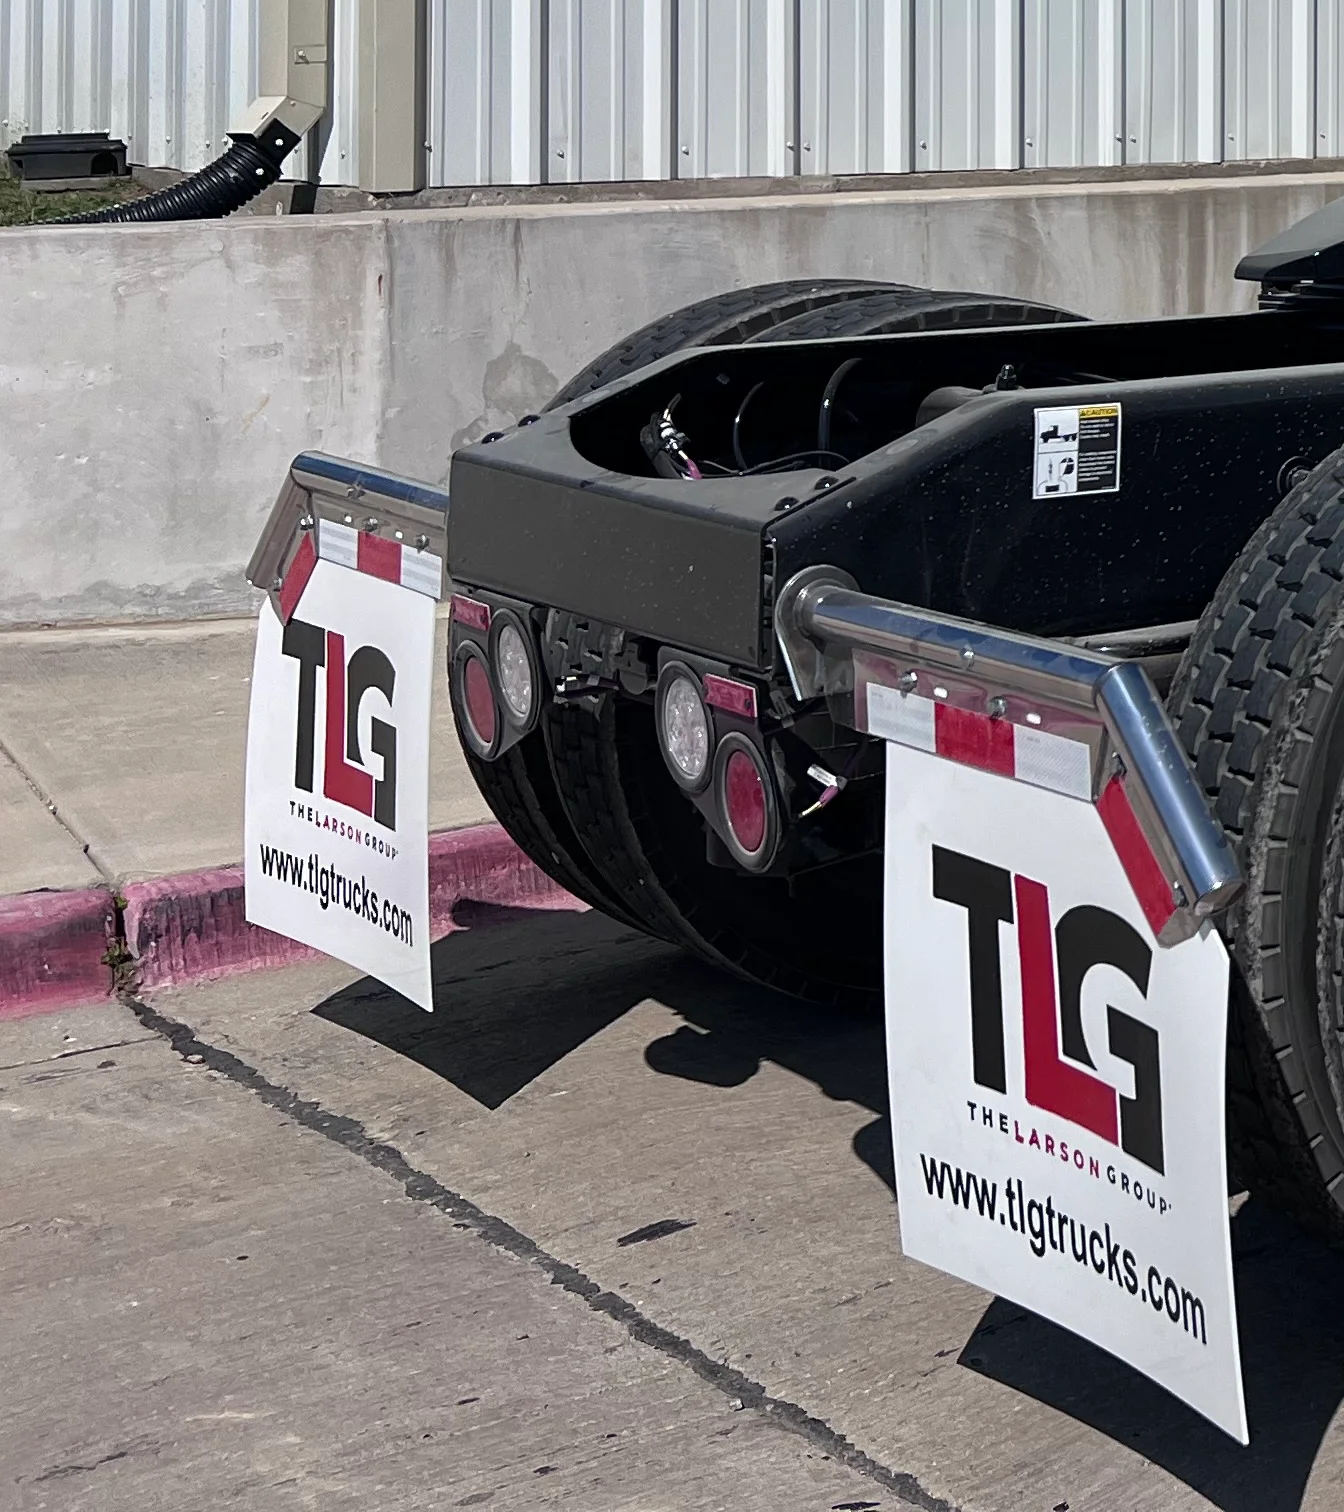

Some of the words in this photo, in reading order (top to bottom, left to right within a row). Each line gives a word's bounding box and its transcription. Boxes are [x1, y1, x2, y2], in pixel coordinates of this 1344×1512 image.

[281, 618, 397, 832] TLG
[260, 843, 413, 948] www.tlgtrucks.com
[932, 843, 1166, 1176] TLG
[920, 1153, 1207, 1346] www.tlgtrucks.com
[967, 1100, 1009, 1135] THE
[1014, 1119, 1100, 1179] LARSON
[1106, 1164, 1168, 1215] GROUP
